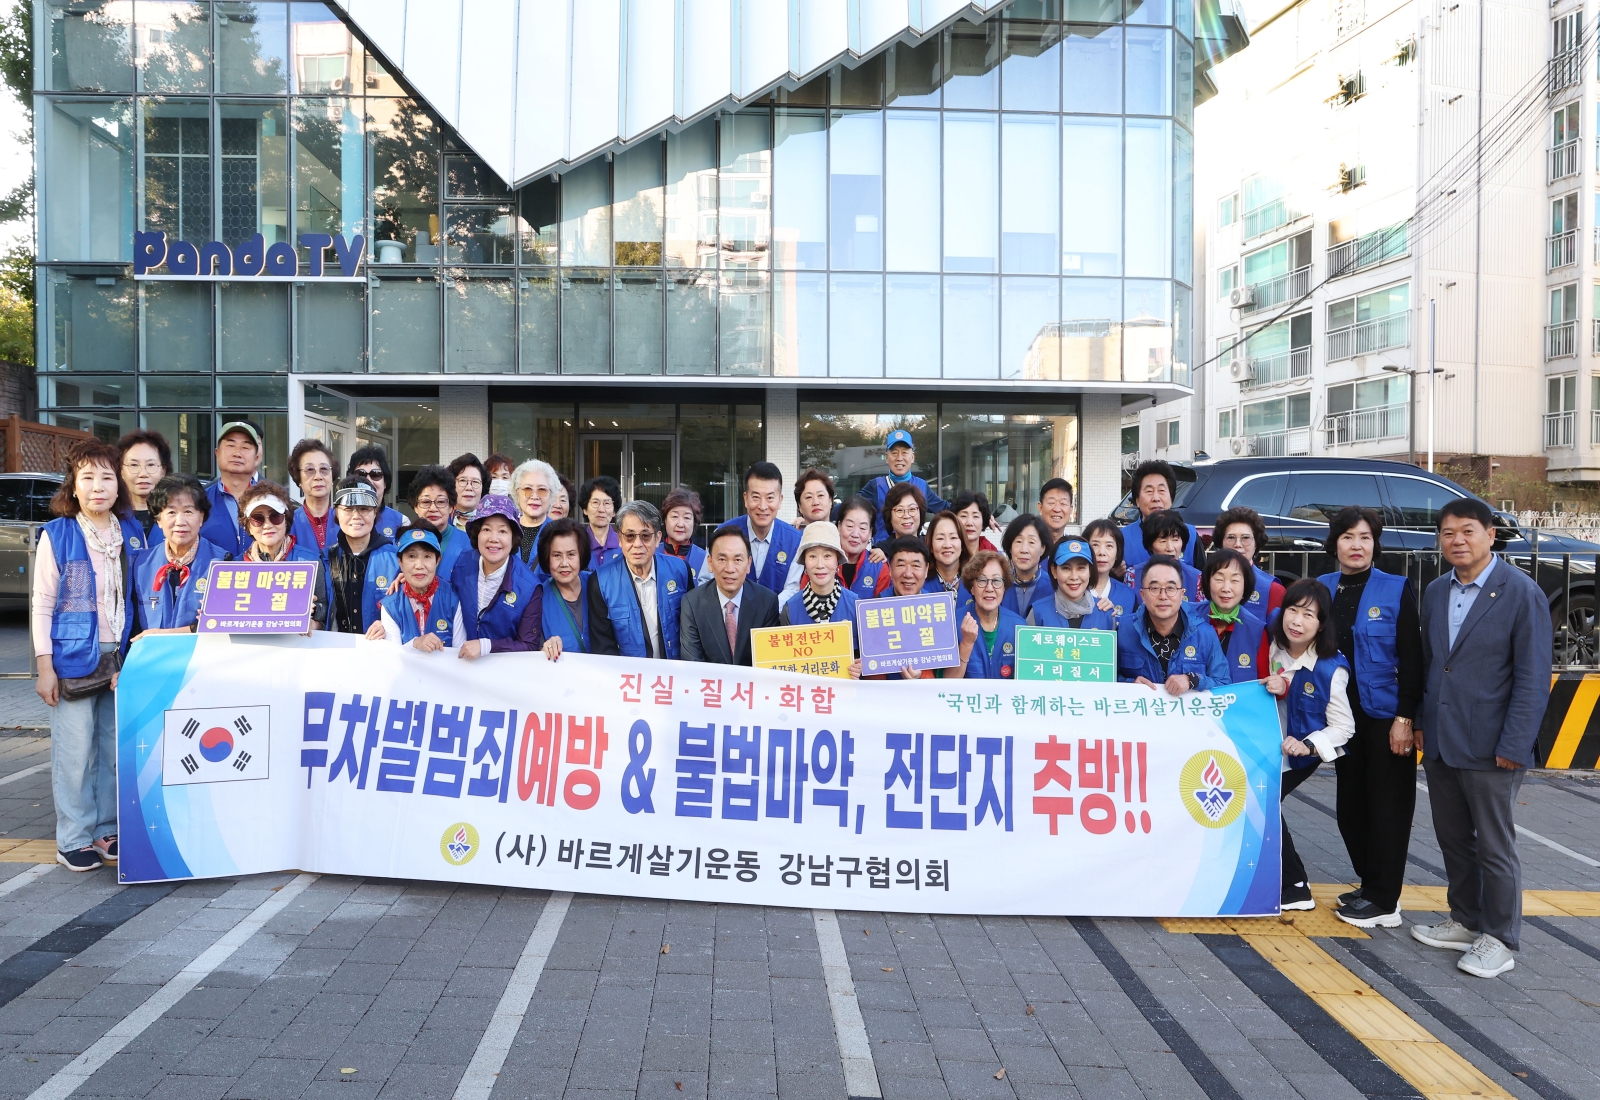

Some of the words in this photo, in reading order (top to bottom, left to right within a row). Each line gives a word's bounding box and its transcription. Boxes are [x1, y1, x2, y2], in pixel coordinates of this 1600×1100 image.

[216, 570, 251, 589] 불법
[256, 570, 308, 590] 마약류
[865, 606, 895, 629] 불법
[901, 602, 948, 625] 마약류
[768, 629, 835, 648] 불법전단지
[1031, 632, 1101, 647] 제로웨이스트
[793, 646, 813, 657] NO
[801, 660, 840, 675] 거리문화
[1011, 694, 1086, 717] 함께하는
[620, 718, 657, 815] &
[675, 721, 866, 835] 불법마약,
[884, 732, 1014, 832] 전단지
[1032, 734, 1152, 836] 추방!!
[495, 831, 548, 867] (사)
[557, 838, 761, 883] 바르게살기운동
[778, 852, 951, 892] 강남구협의회
